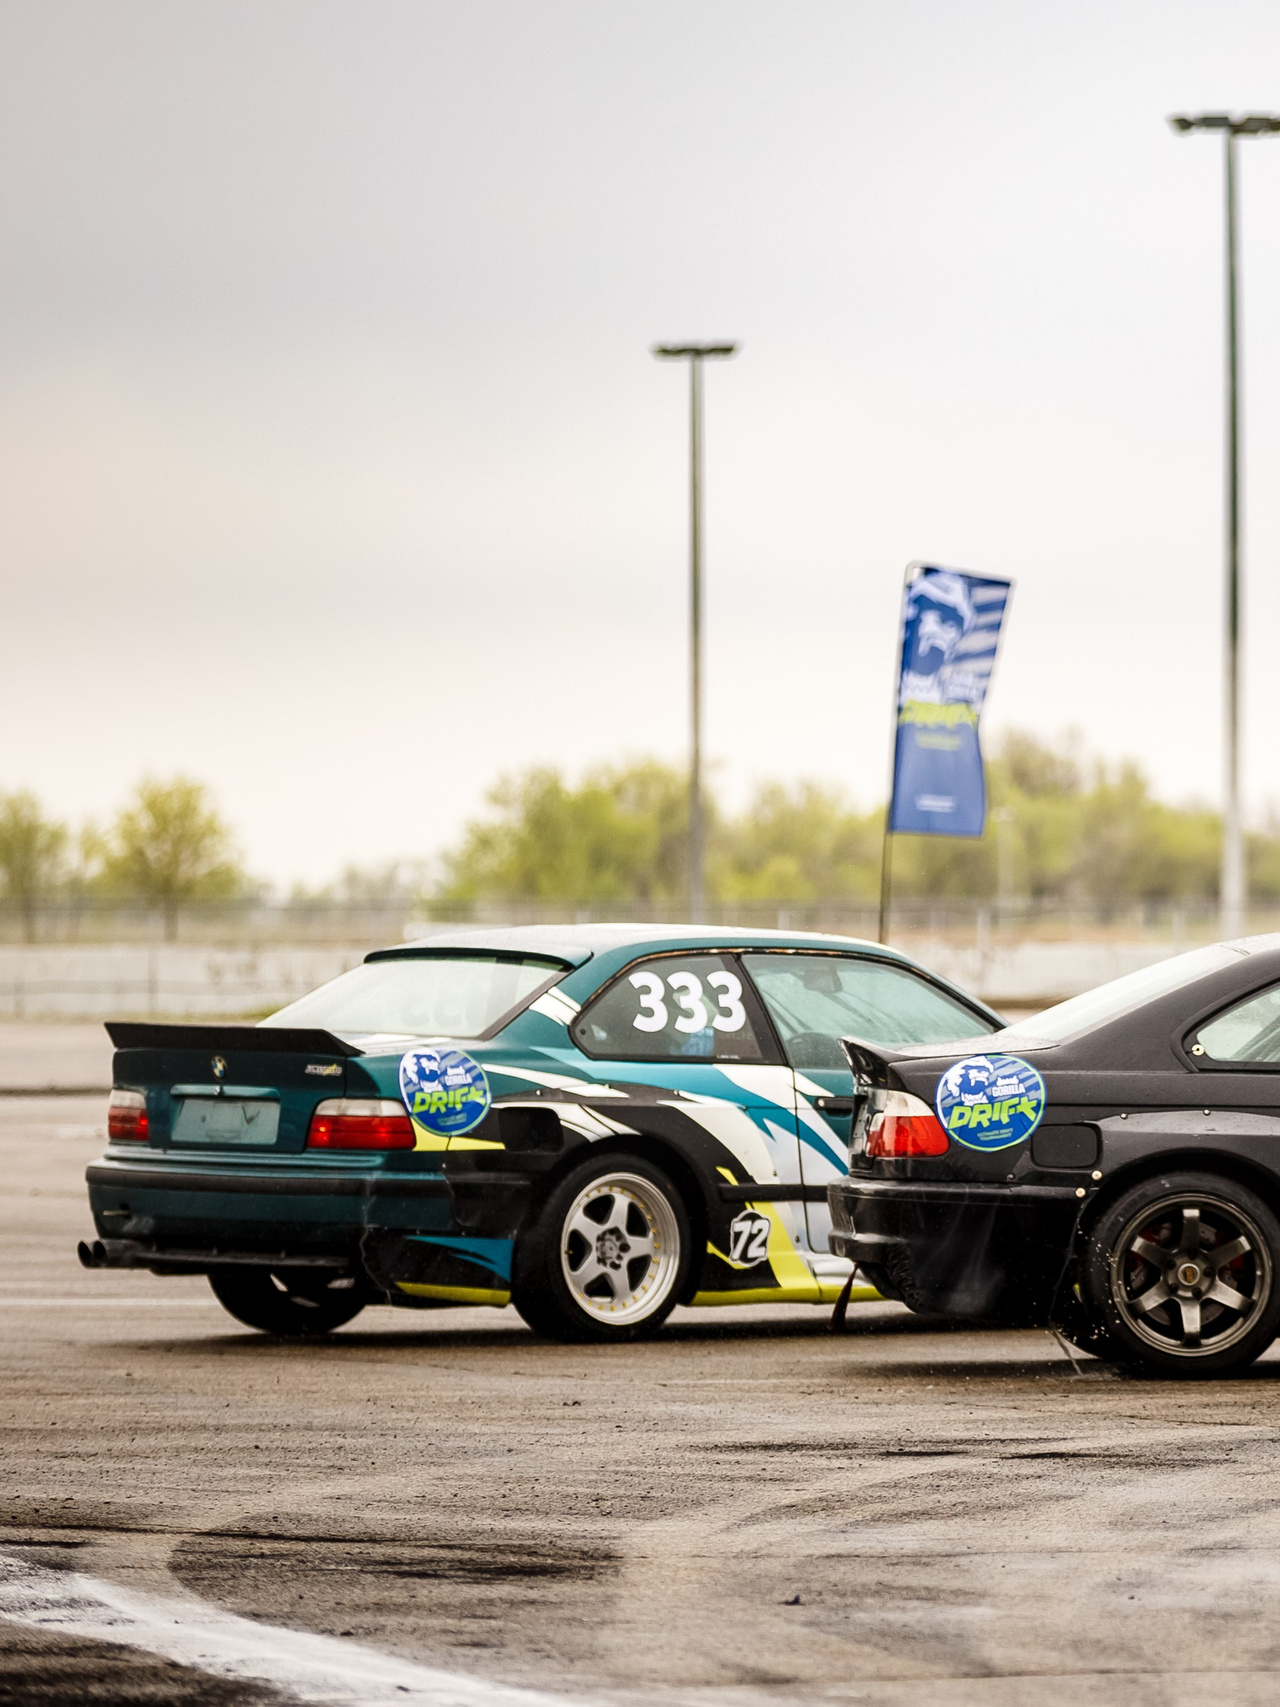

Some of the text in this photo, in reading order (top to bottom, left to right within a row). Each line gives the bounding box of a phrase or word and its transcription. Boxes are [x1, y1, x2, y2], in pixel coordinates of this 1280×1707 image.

[628, 970, 746, 1033] 333
[992, 1082, 1026, 1097] GORILLA
[731, 1219, 770, 1260] 72
